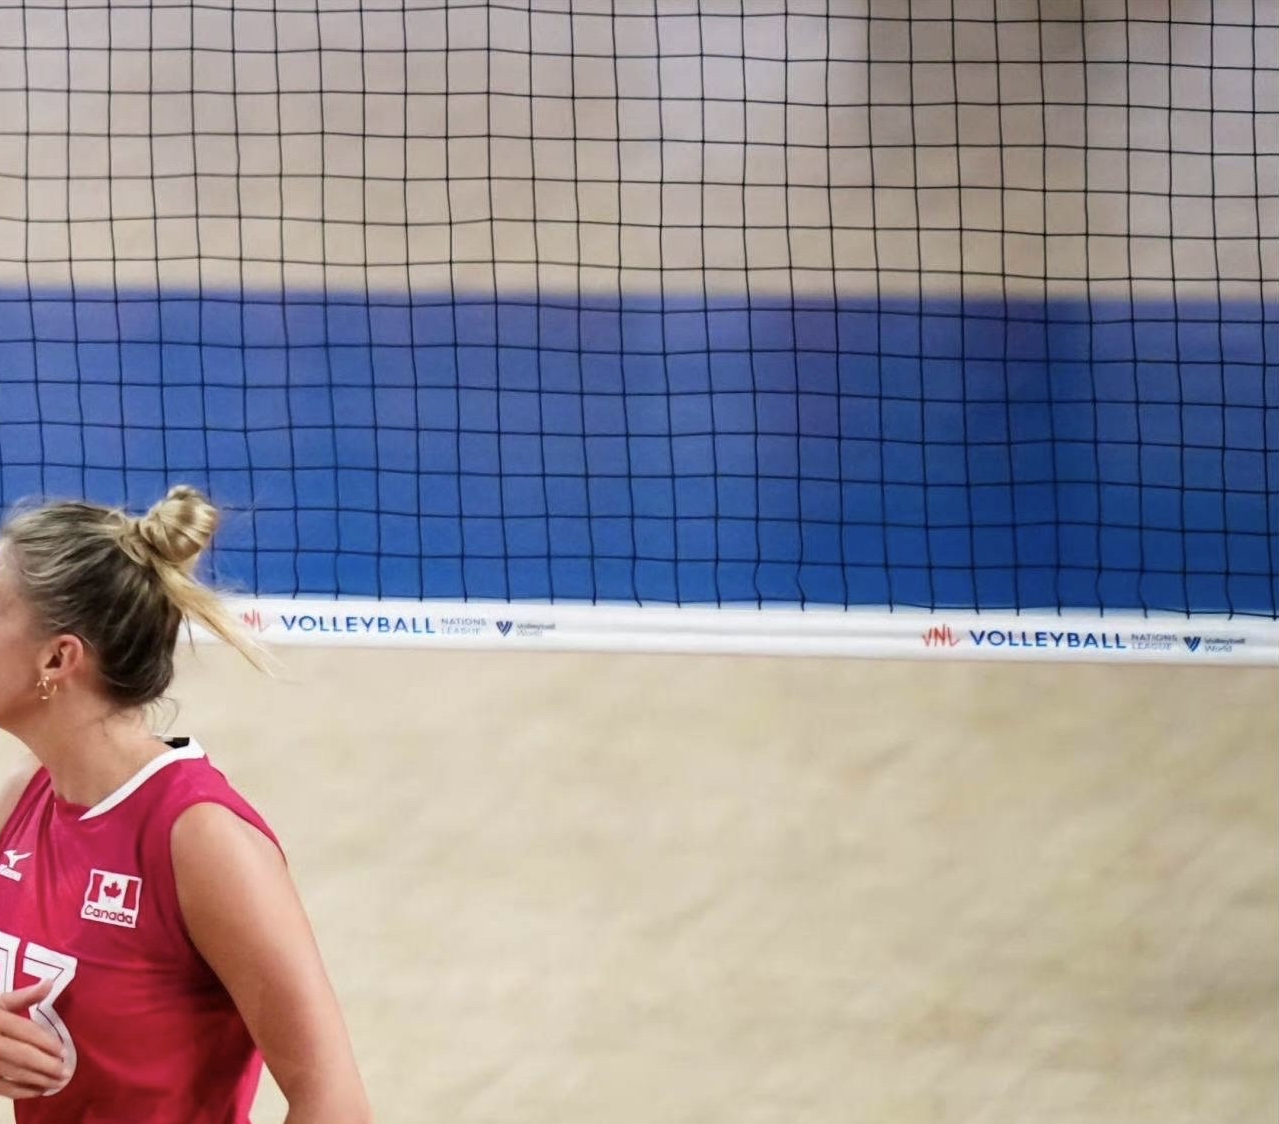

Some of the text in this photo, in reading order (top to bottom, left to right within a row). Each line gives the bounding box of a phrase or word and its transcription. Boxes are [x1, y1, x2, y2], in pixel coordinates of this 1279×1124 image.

[280, 614, 436, 634] VOLLEYBALL
[969, 628, 1127, 649] VOLLEYBALL
[83, 903, 134, 925] Canada
